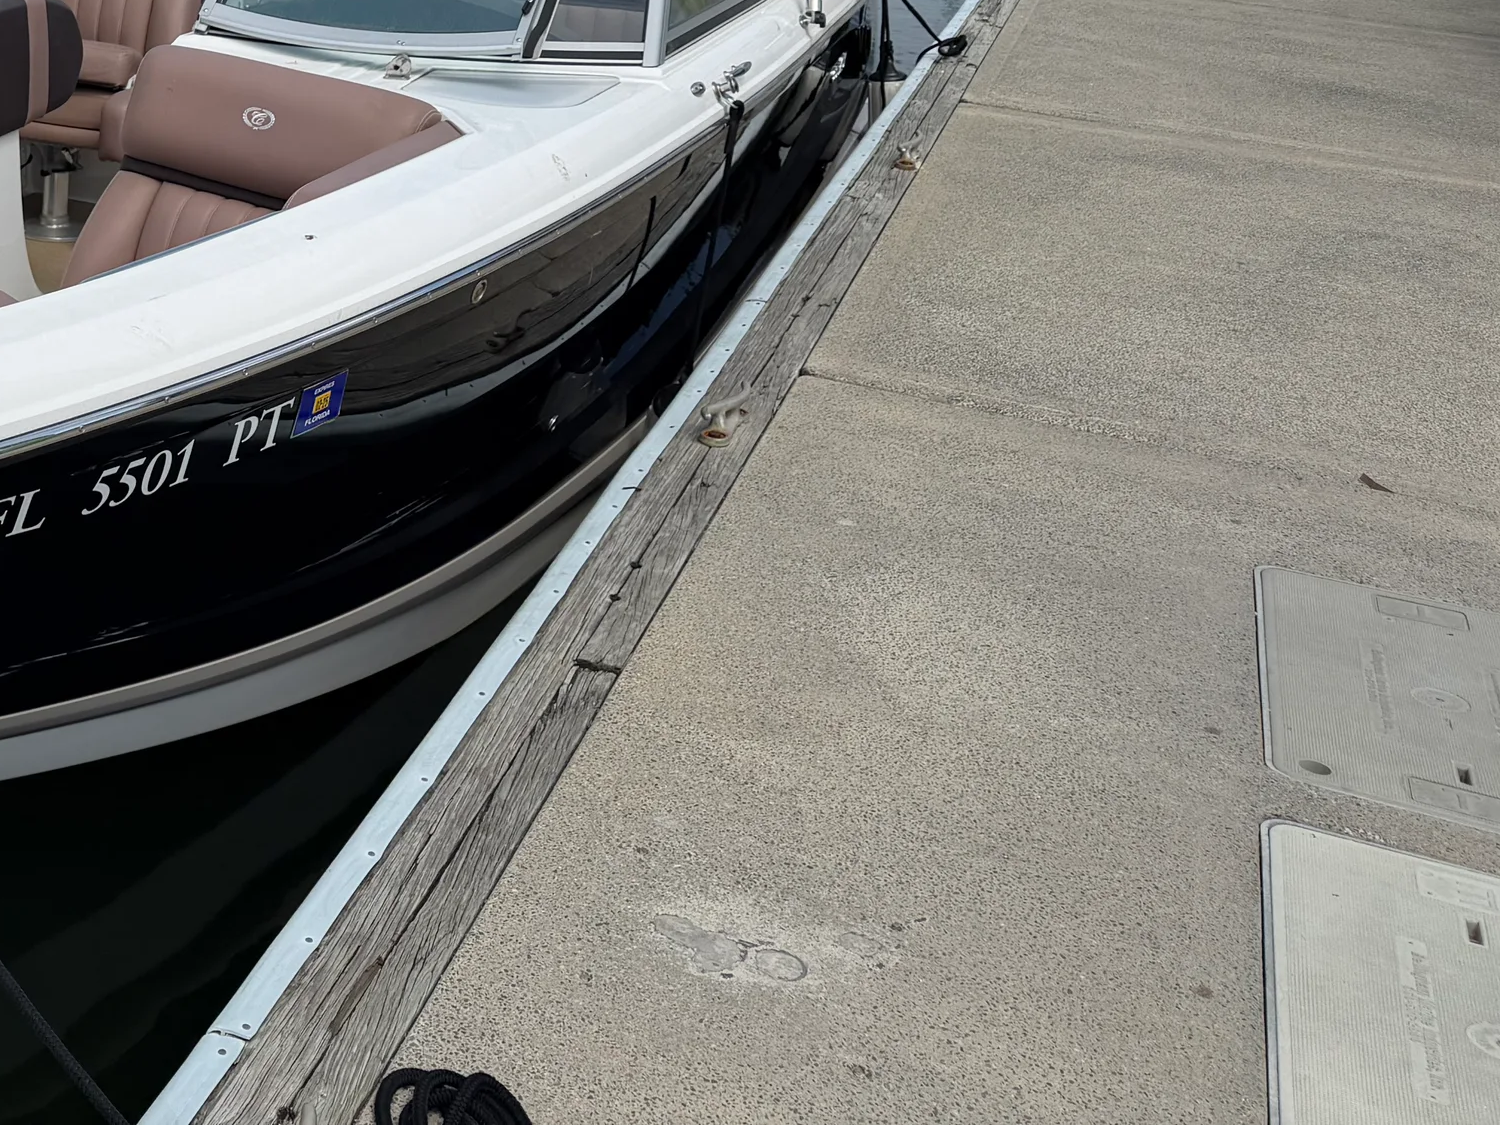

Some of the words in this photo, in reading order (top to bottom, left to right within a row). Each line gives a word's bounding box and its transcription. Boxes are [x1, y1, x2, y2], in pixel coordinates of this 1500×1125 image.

[304, 409, 331, 427] FLORIDA
[81, 438, 196, 516] 5501
[222, 397, 296, 467] PT
